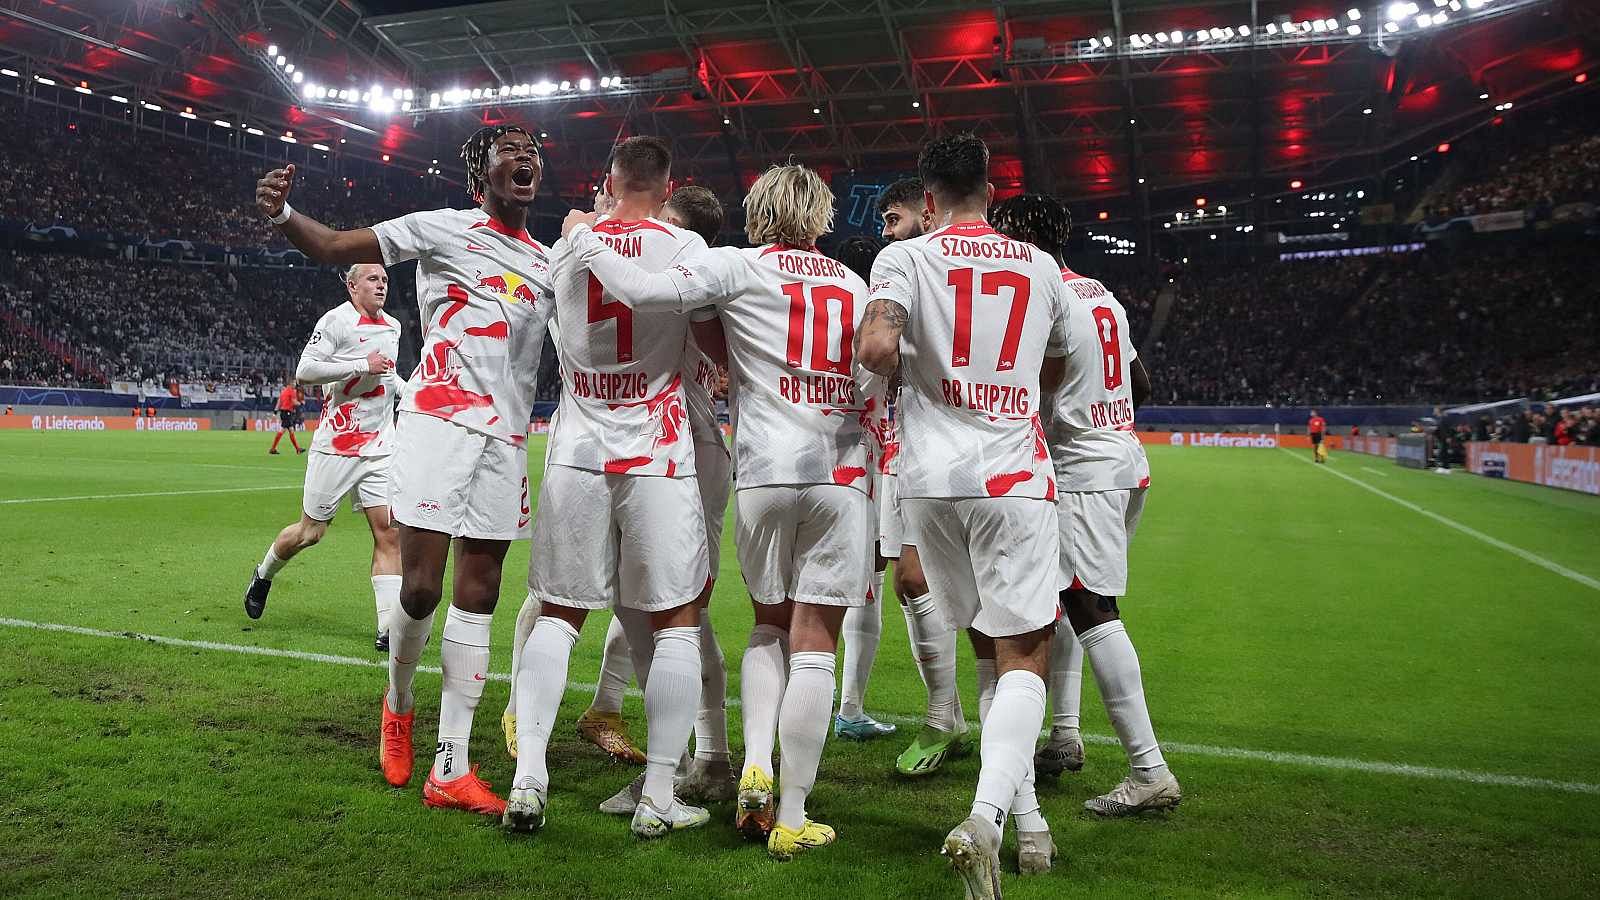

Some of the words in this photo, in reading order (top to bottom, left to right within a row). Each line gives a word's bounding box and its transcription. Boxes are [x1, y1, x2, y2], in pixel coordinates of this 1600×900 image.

[598, 233, 642, 257] BÁN
[941, 238, 1032, 263] SZOBOSZLAI
[778, 254, 846, 279] FORSBERG
[588, 267, 633, 362] 4
[781, 281, 855, 376] 10
[948, 267, 1031, 372] 17
[1092, 306, 1123, 391] 8
[574, 372, 591, 398] RB
[593, 372, 648, 400] LEIPZIG
[779, 376, 801, 403] RB
[806, 376, 856, 405] LEIPZIG
[942, 378, 962, 408] RB
[967, 382, 1029, 415] LEIPZIG
[46, 416, 105, 431] Lieferando
[147, 417, 198, 431] Lieferando
[1090, 401, 1107, 428] RB
[1108, 398, 1132, 426] LEZIG
[1190, 433, 1276, 448] Lieferando
